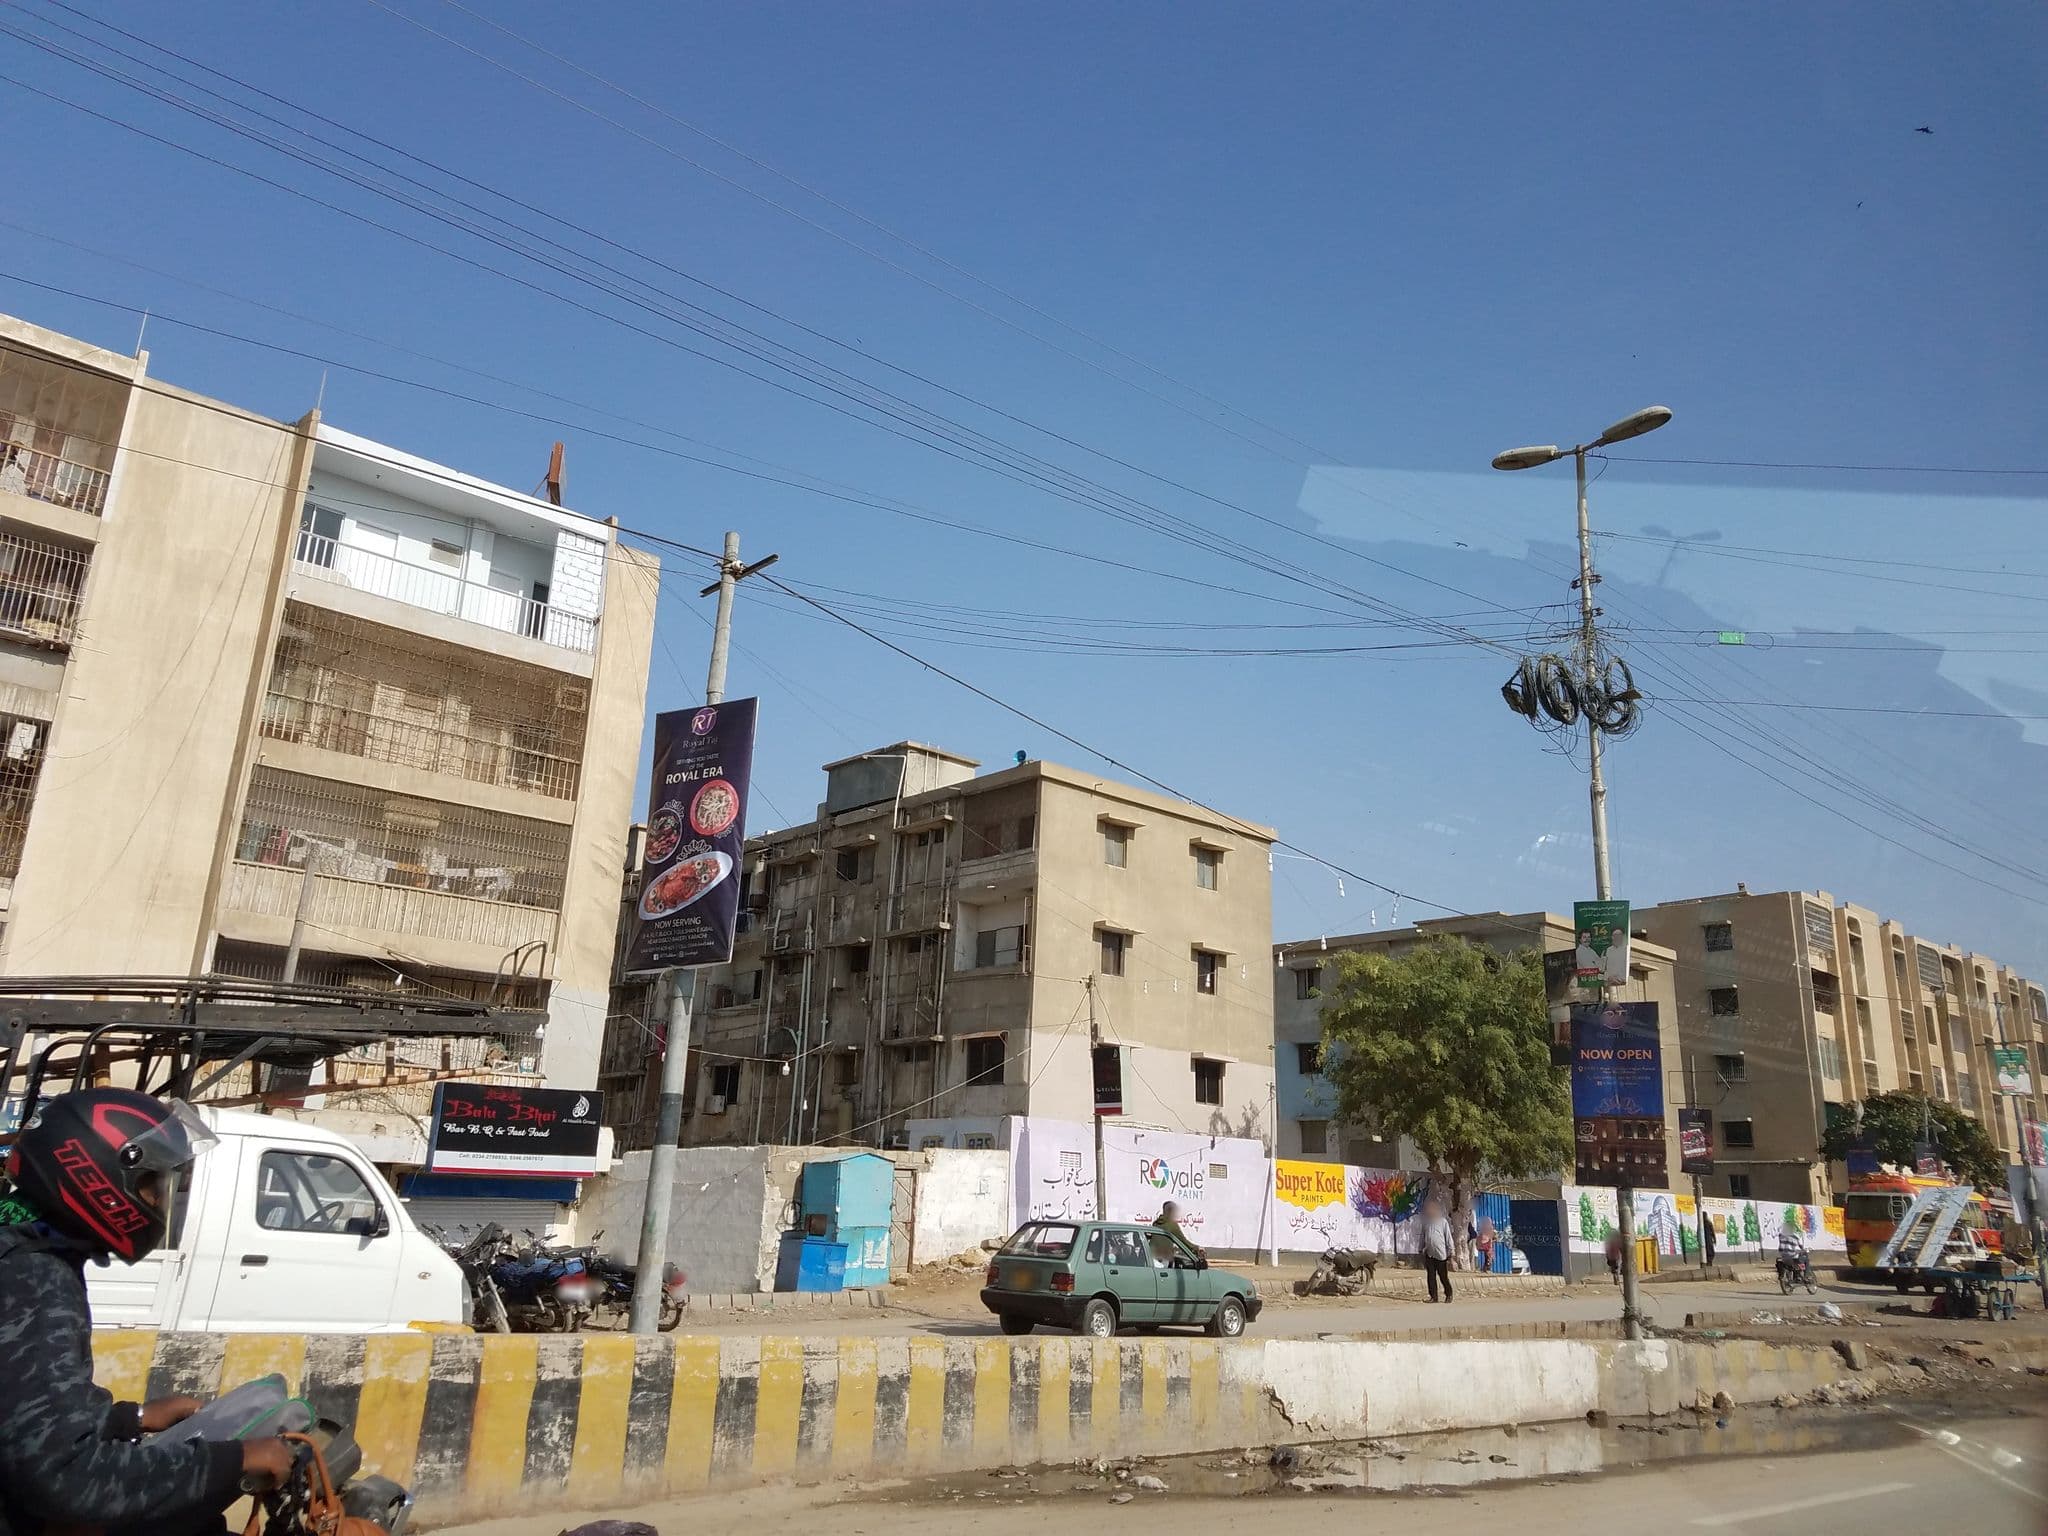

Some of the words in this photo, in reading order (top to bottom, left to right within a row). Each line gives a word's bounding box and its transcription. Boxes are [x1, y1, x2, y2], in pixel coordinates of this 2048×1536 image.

[665, 769, 700, 785] ROYAL
[702, 766, 724, 779] ERA
[654, 919, 672, 930] NOW
[672, 916, 702, 928] SERVING
[1580, 1049, 1614, 1060] NOW
[1617, 1049, 1653, 1060] OPEN
[443, 1122, 466, 1133] Bar
[506, 1125, 527, 1137] Fast
[527, 1127, 551, 1138] Food
[53, 1139, 149, 1236] TECH
[1276, 1167, 1312, 1197] Super
[1315, 1171, 1343, 1194] Kote
[1177, 1190, 1204, 1200] PAINT
[1300, 1194, 1324, 1203] PAINTS
